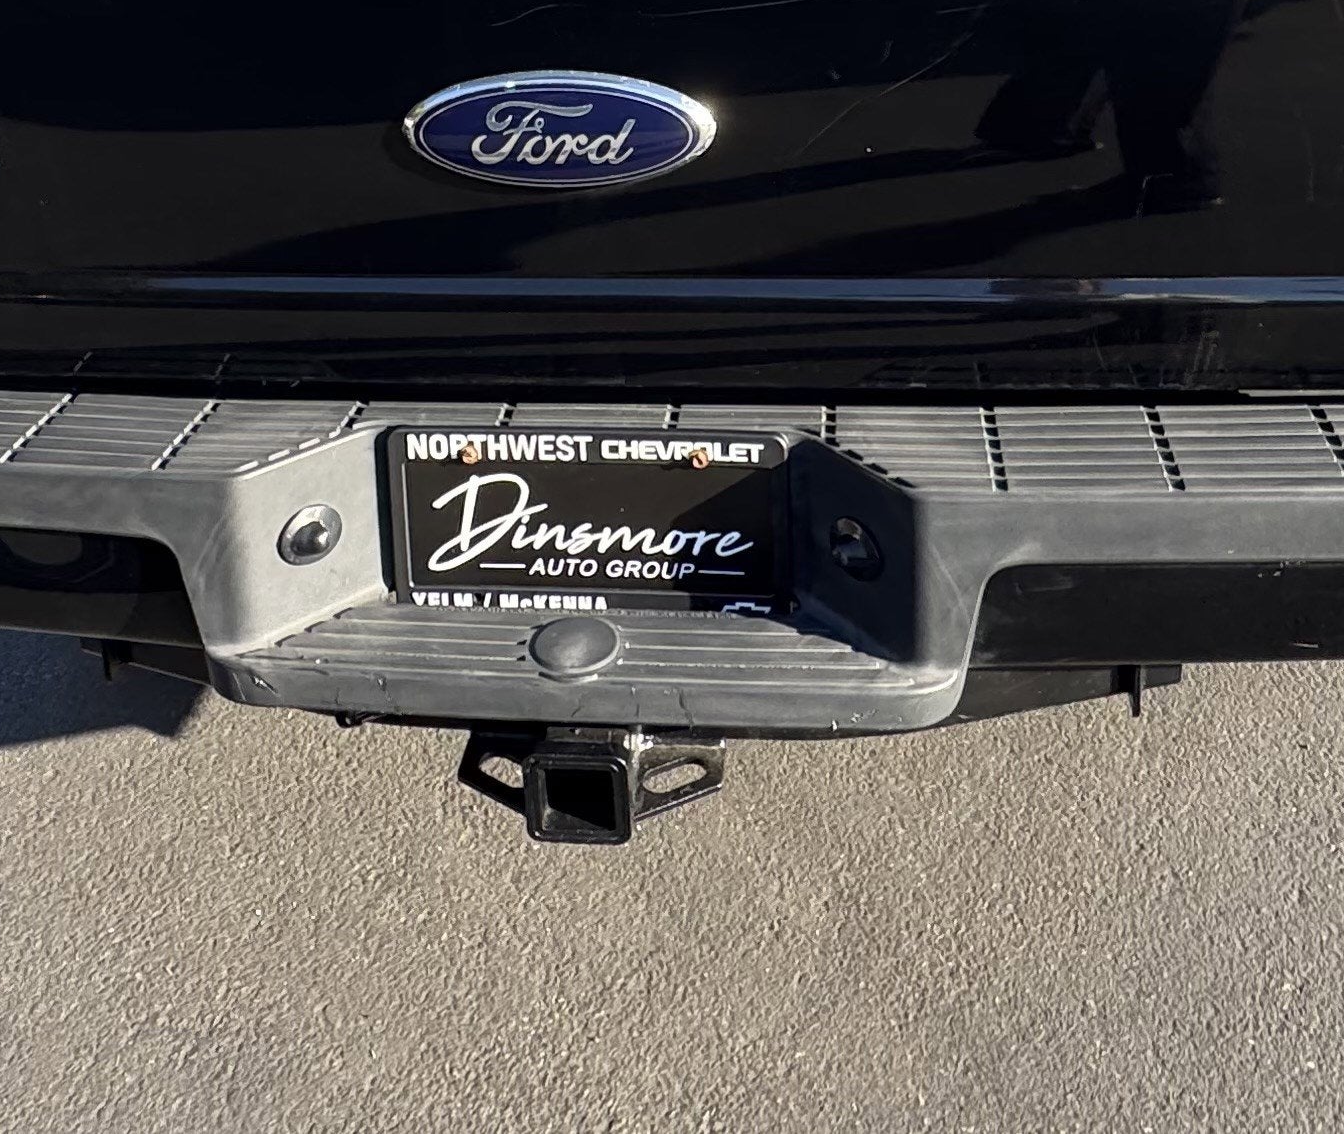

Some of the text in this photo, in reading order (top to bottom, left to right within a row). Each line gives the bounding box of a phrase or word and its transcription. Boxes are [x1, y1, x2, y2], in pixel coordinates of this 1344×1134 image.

[471, 100, 637, 165] Ford
[406, 433, 765, 464] NORTHWEST CHEVROLET
[428, 473, 755, 572] Dinsmore
[528, 557, 696, 579] AUTO GROUP
